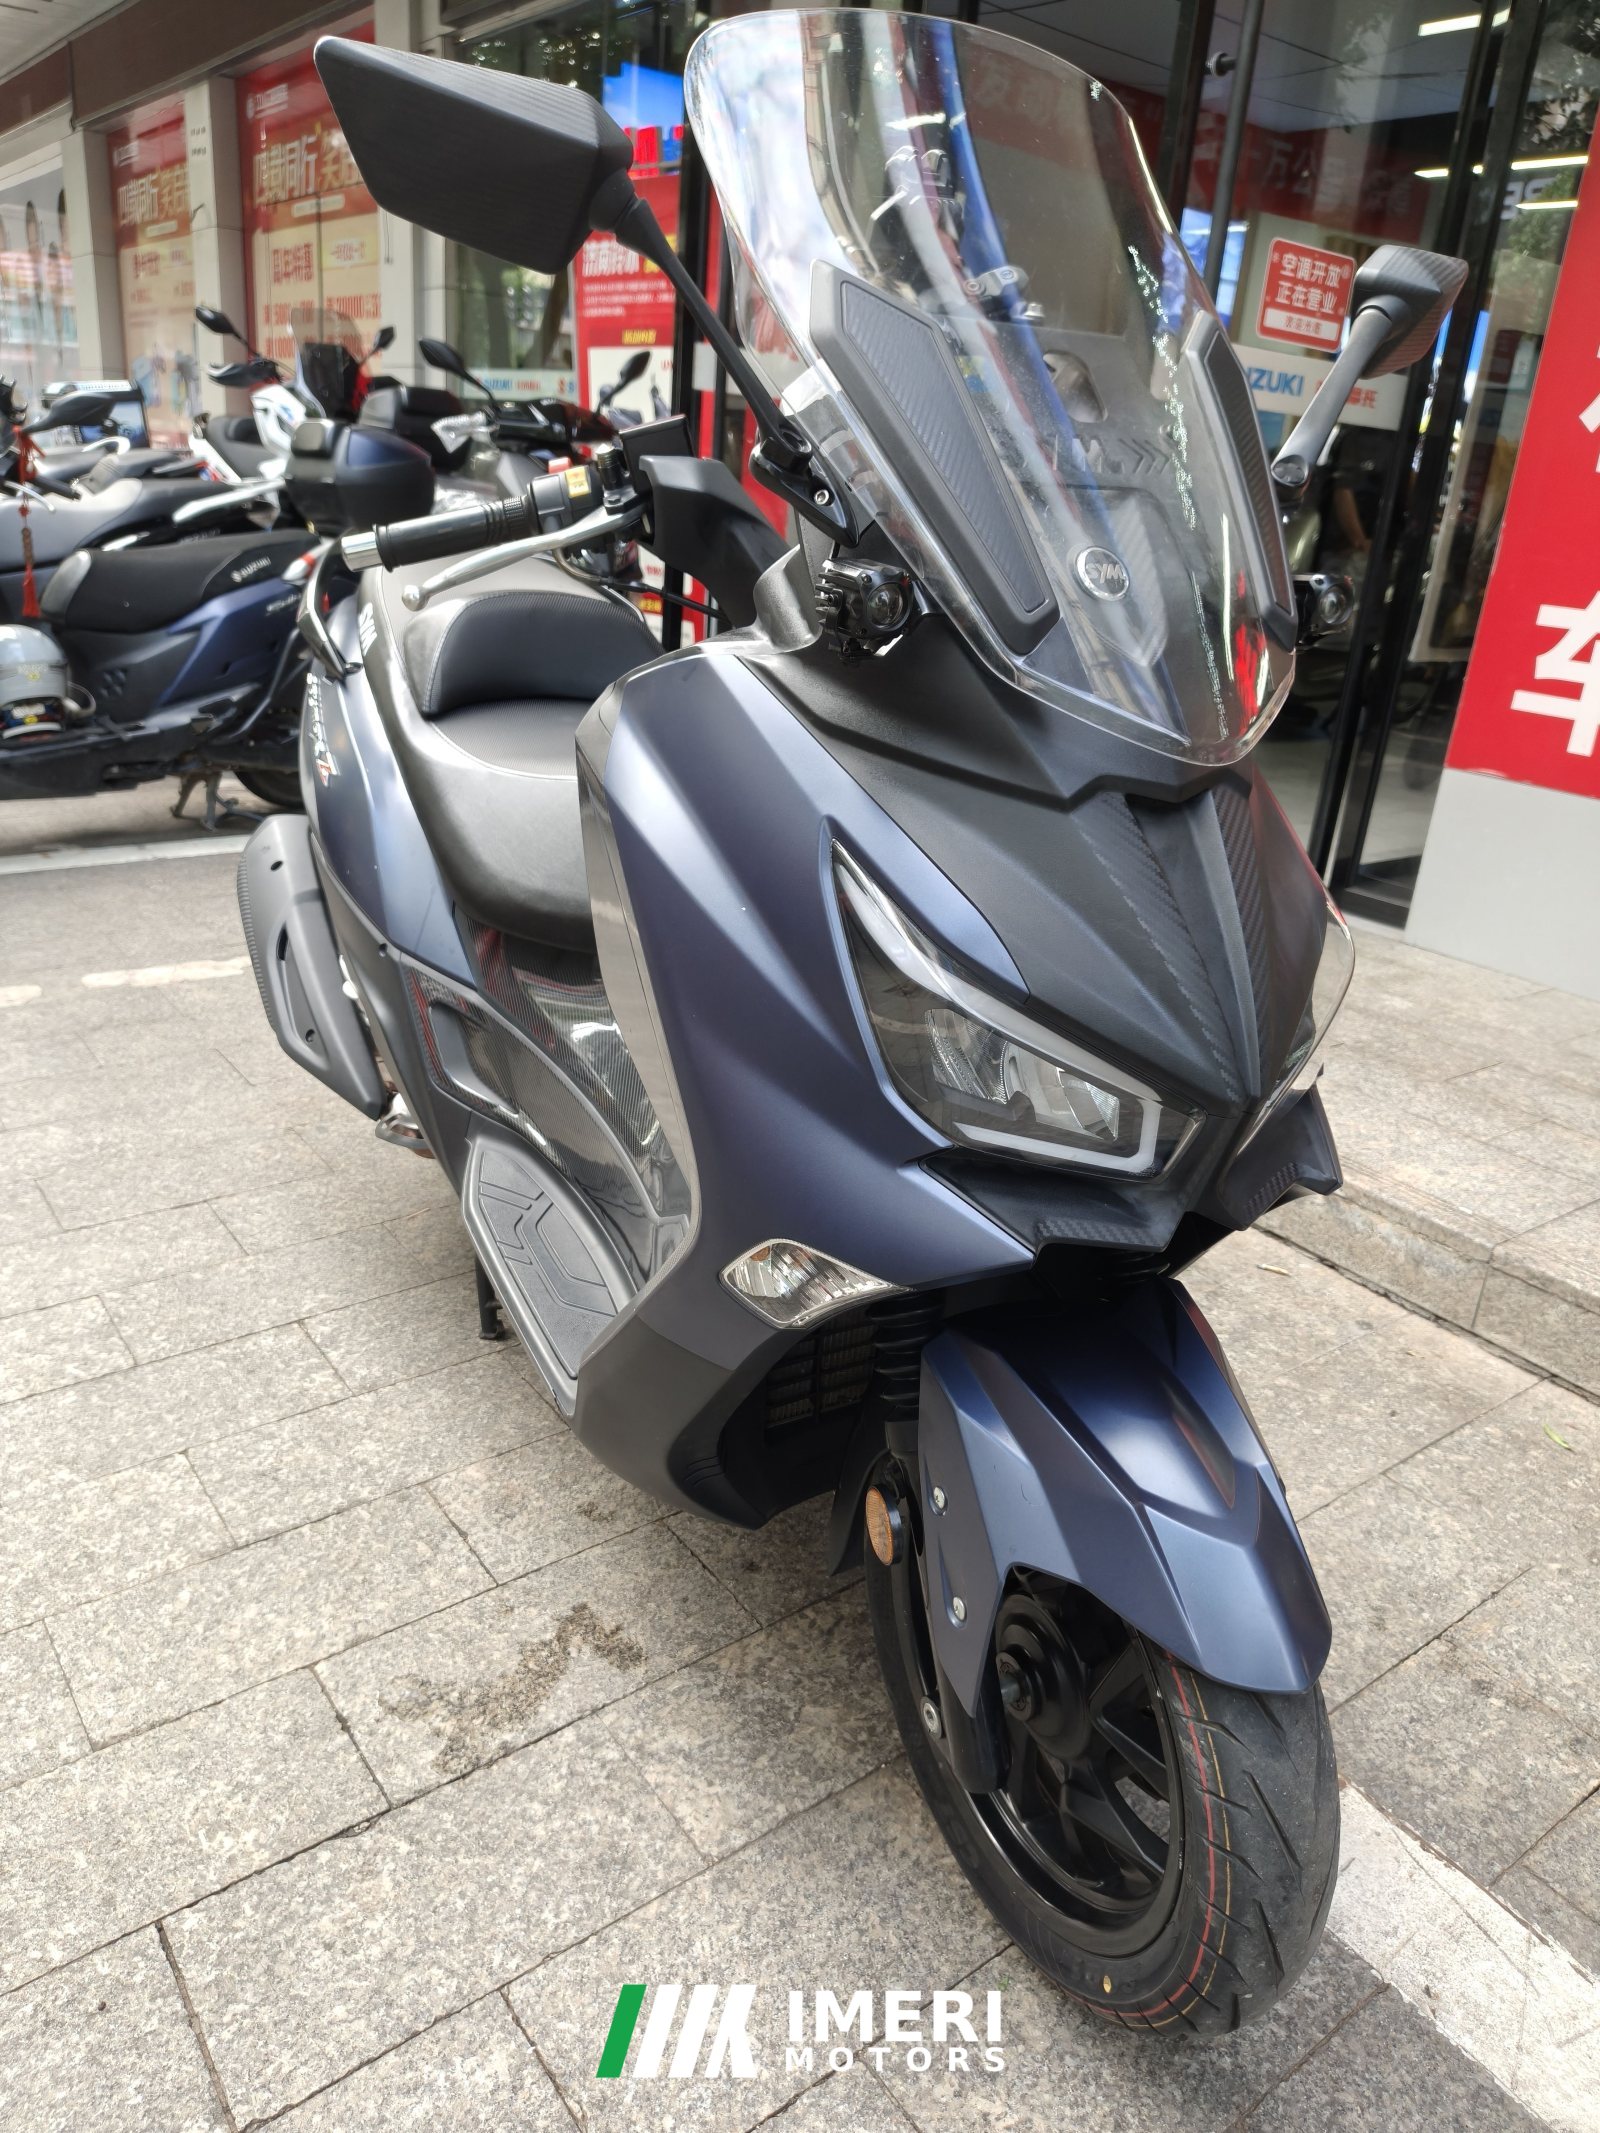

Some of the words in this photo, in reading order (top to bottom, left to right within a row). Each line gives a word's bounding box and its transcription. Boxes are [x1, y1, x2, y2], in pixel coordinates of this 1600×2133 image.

[1279, 252, 1341, 288] 空调开放
[1275, 280, 1337, 314] 正在营业
[1084, 562, 1126, 584] SYM
